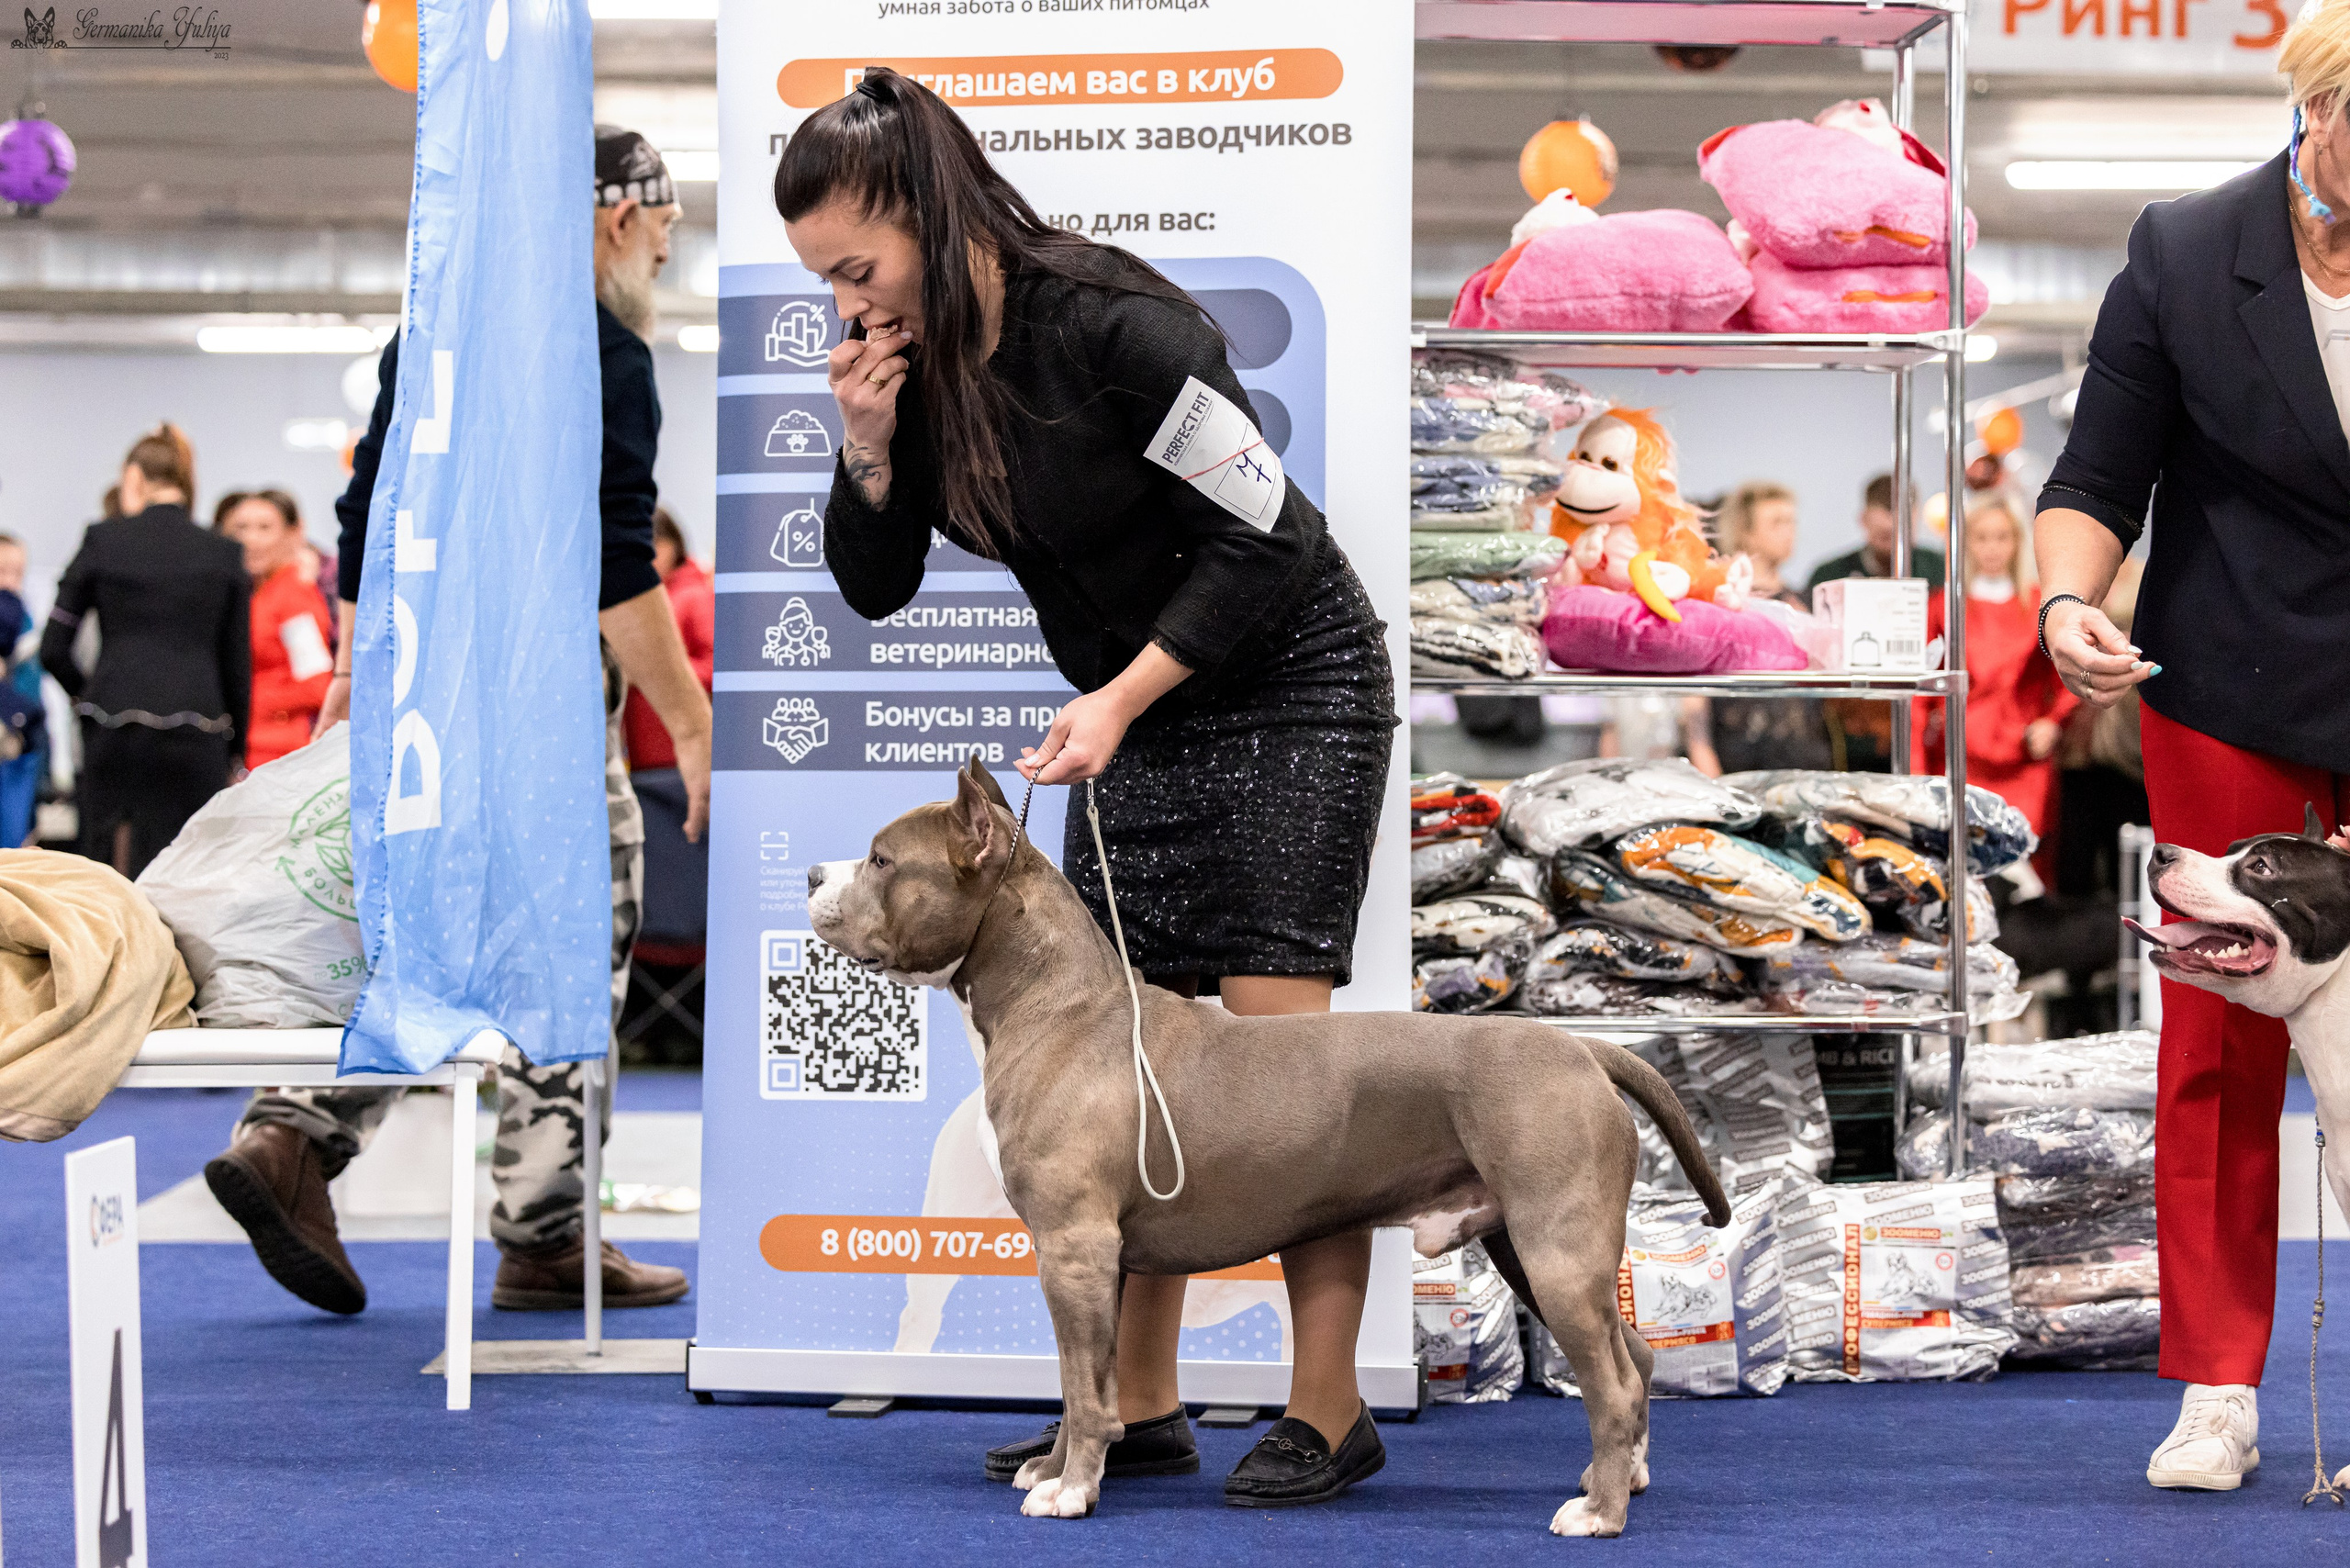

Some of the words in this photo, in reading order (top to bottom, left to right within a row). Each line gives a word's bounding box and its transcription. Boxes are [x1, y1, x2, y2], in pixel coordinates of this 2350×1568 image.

[878, 1, 941, 19] умная
[946, 0, 1014, 14] забота
[1021, 0, 1033, 13] о
[1038, 0, 1103, 12] ваших
[1110, 0, 1210, 12] питомцах
[1086, 70, 1147, 95] вас
[1157, 70, 1179, 94] в
[1188, 57, 1276, 98] клуб
[1135, 122, 1352, 154] заводчиков
[1091, 214, 1149, 236] для
[1159, 212, 1215, 230] вас:
[1162, 412, 1199, 464] PERFECT
[1191, 391, 1209, 414] FIT
[865, 700, 974, 734] Бонусы
[980, 706, 1013, 727] за
[865, 742, 1005, 764] клиентов
[821, 1228, 839, 1256] 8
[847, 1226, 922, 1262] (800)
